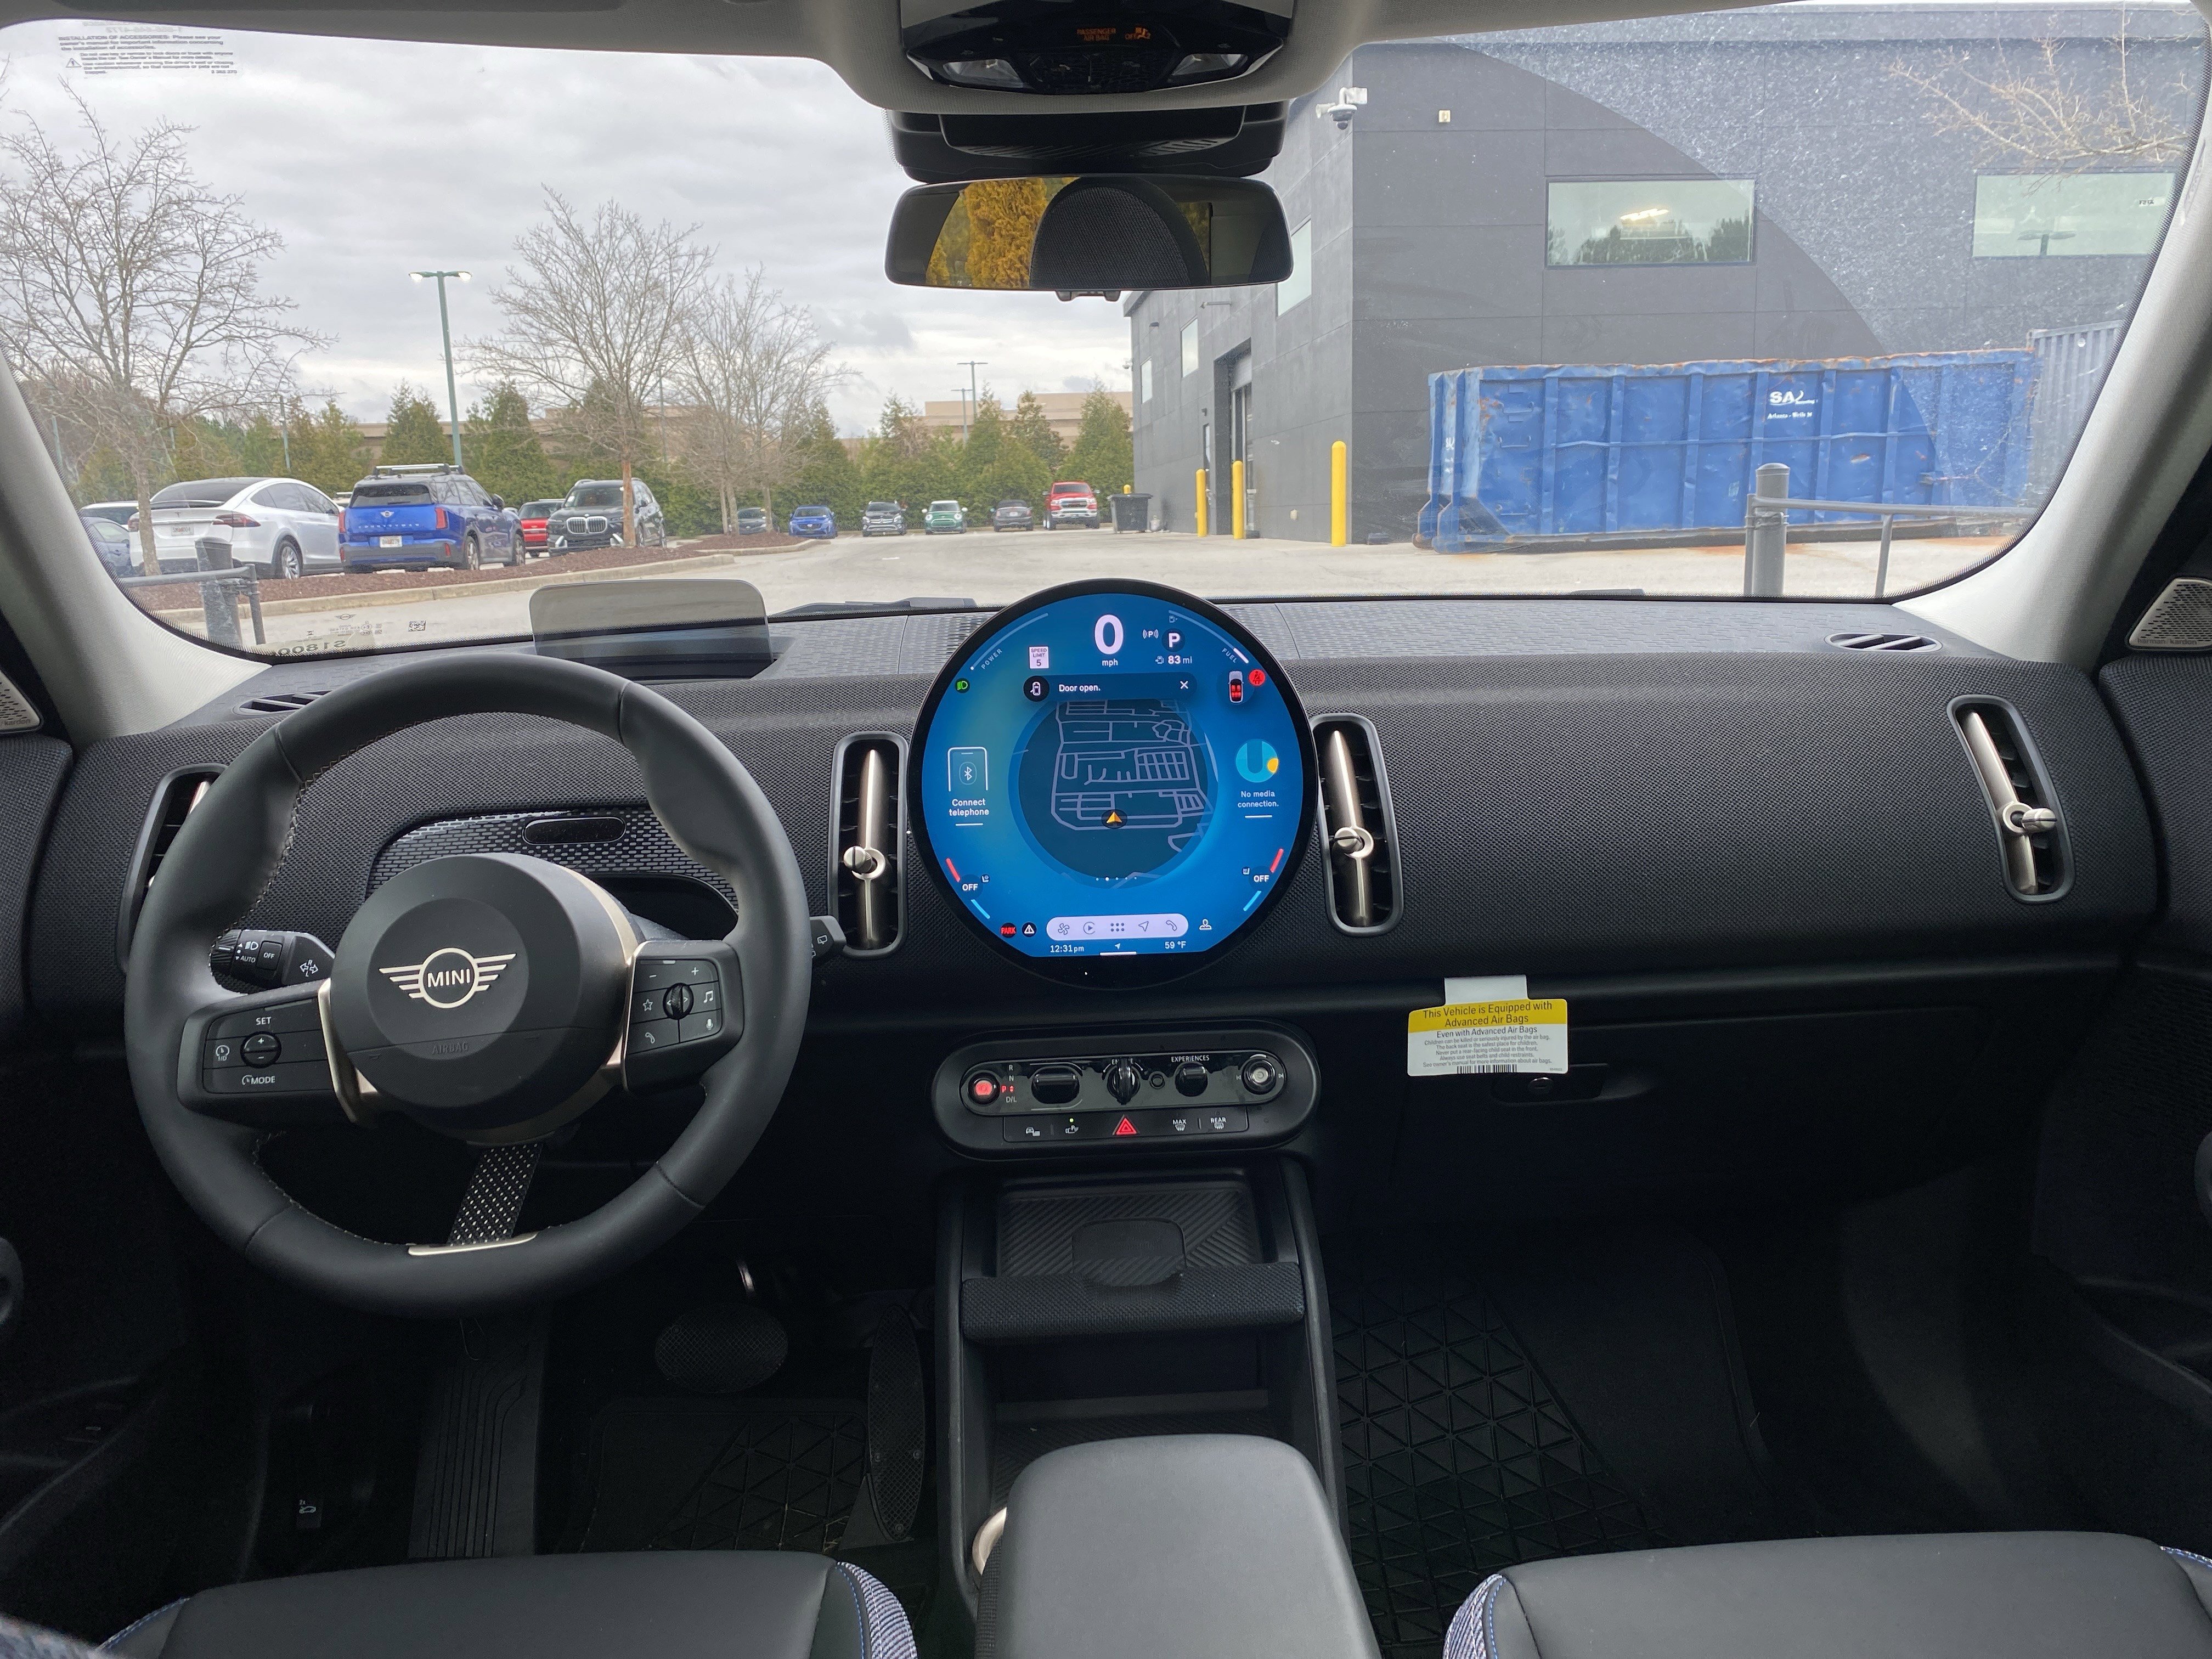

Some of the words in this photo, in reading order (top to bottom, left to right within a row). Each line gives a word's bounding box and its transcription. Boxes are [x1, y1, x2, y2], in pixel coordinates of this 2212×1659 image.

[1094, 614, 1124, 655] 0
[1168, 633, 1180, 648] P
[981, 648, 1003, 670] POWER
[1167, 655, 1181, 664] 83
[1222, 648, 1237, 663] FUEL
[1102, 658, 1119, 668] mph
[1058, 684, 1077, 692] Door
[1079, 684, 1101, 694] open.
[952, 798, 986, 806] Connect
[949, 808, 989, 817] telephone
[1165, 941, 1175, 950] 59
[427, 968, 470, 988] MINI
[1423, 1009, 1441, 1019] This
[1443, 1006, 1476, 1017] Vehicle
[1479, 1005, 1486, 1014] is
[1488, 1001, 1531, 1014] Equipped
[1533, 1001, 1552, 1010] with
[256, 1017, 272, 1025] SET
[1445, 1015, 1489, 1028] Advanced
[1491, 1015, 1504, 1024] Air
[1506, 1014, 1529, 1025] Bags
[1471, 1026, 1506, 1036] Advanced
[1519, 1025, 1537, 1035] Bags
[432, 1041, 469, 1054] AIRBAG
[251, 1076, 275, 1085] MODE
